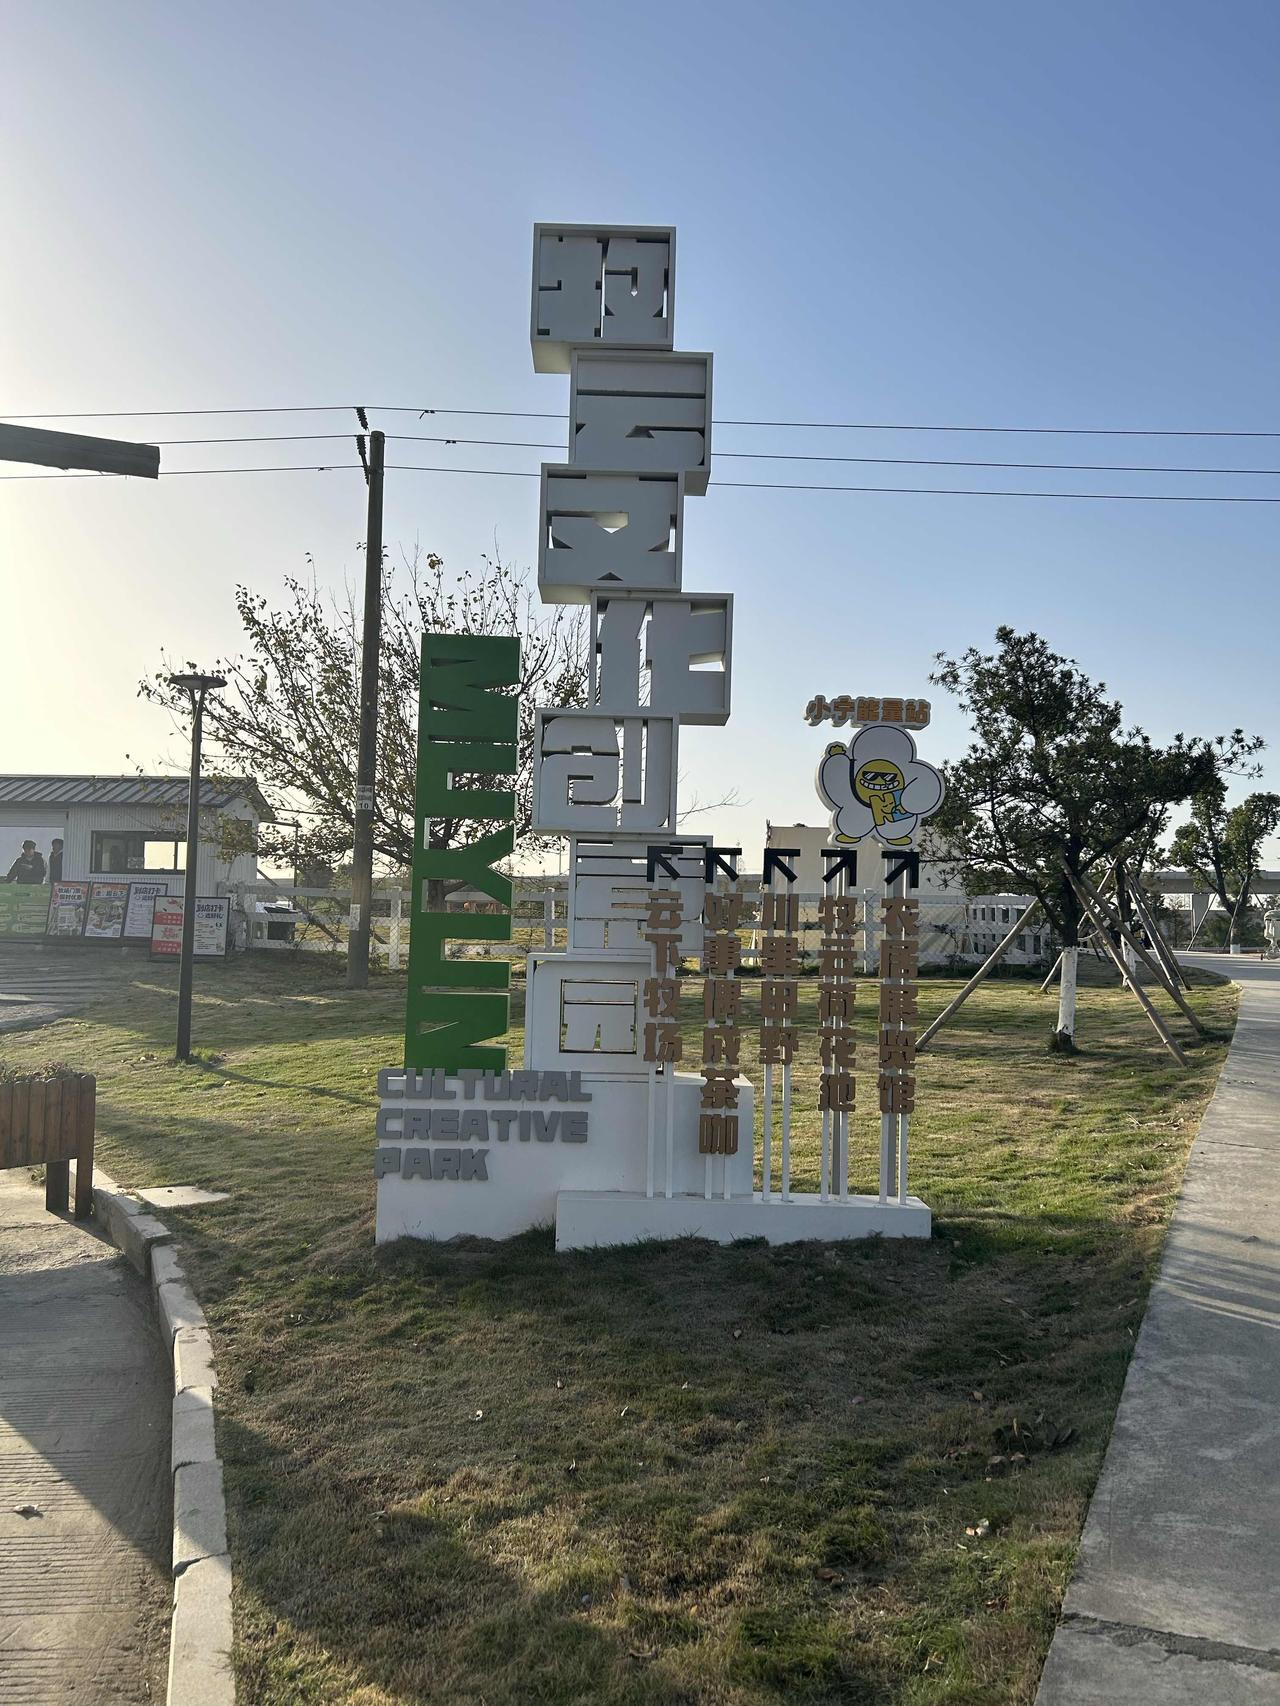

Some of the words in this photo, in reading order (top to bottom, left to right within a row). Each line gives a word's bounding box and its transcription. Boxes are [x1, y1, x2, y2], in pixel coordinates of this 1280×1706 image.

[806, 695, 930, 725] 小宁能量站
[644, 891, 684, 1062] 云下牧场
[759, 893, 800, 1065] 川里田野
[817, 894, 858, 1113] 牧云荷花池
[376, 1069, 593, 1103] CULTURAL
[374, 1108, 589, 1144] CREATIVE
[373, 1148, 490, 1182] PARK
